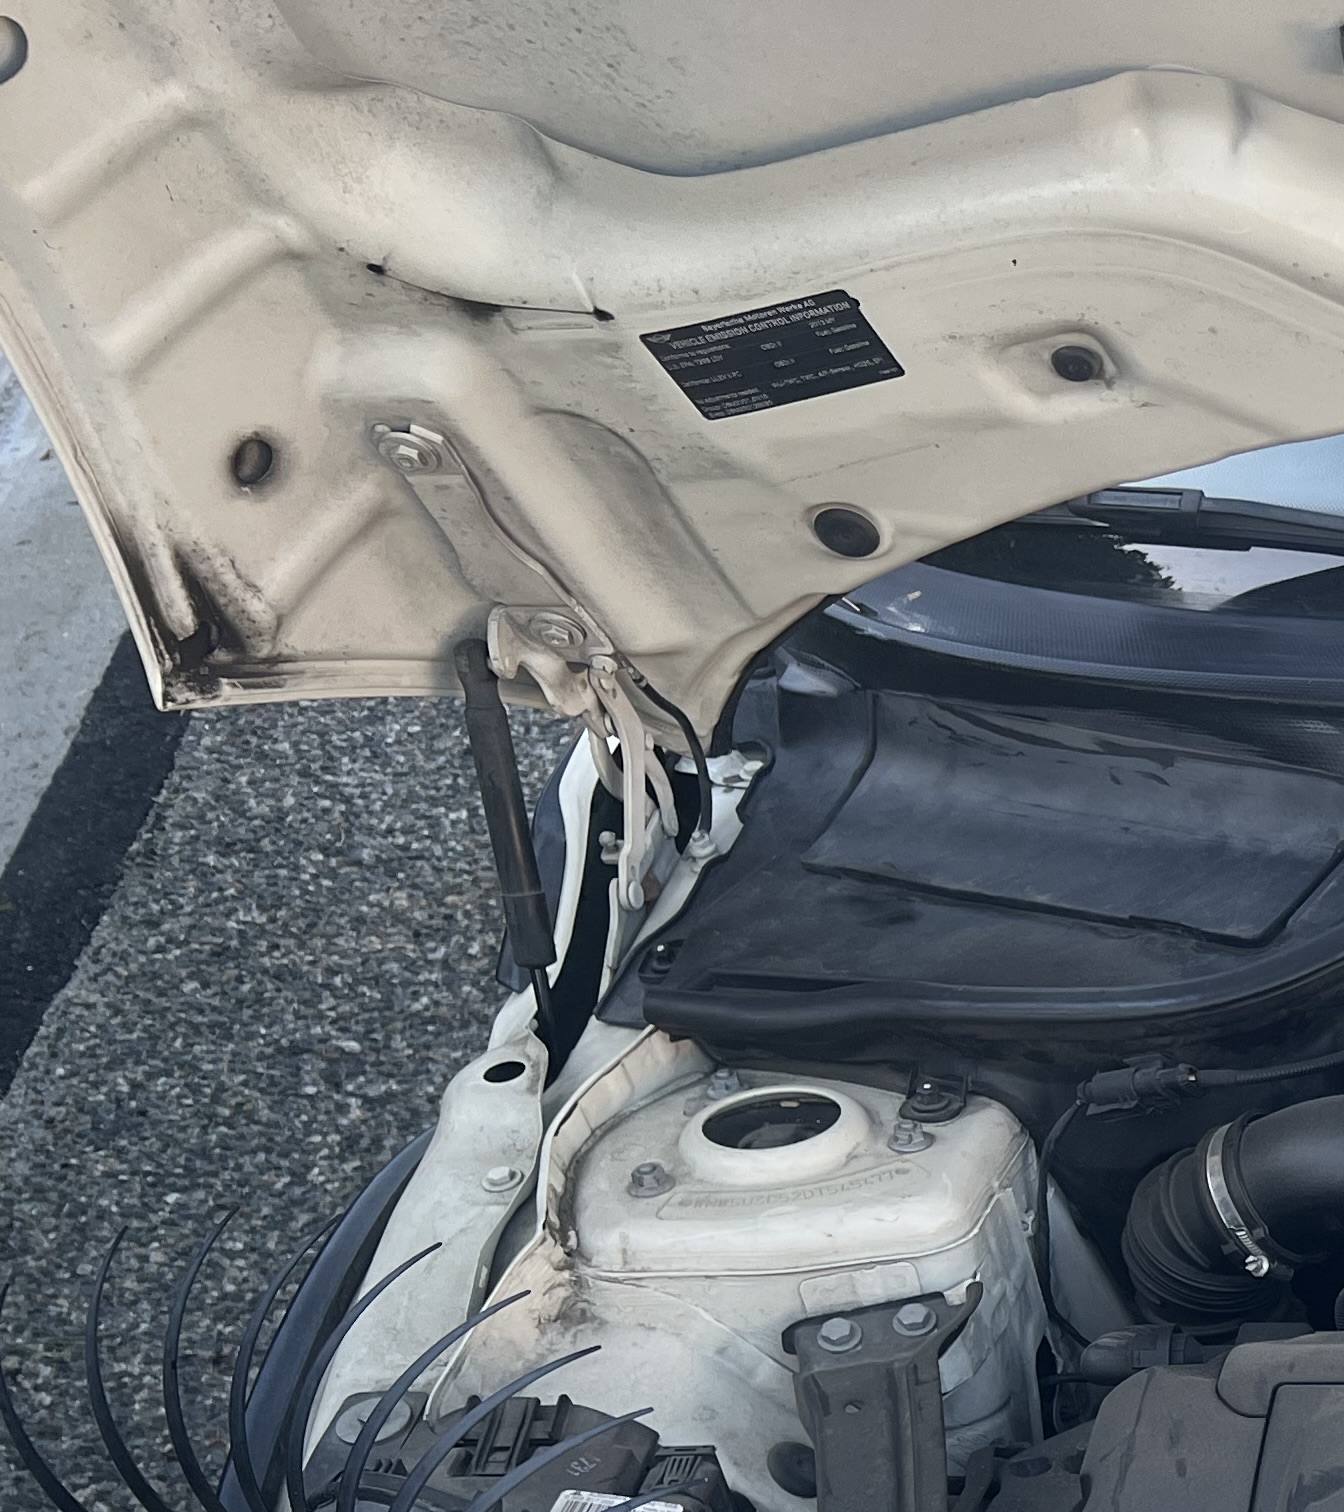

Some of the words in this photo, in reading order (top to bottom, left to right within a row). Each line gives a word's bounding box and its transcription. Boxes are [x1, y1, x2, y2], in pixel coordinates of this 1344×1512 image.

[670, 337, 705, 349] VEHICLE
[705, 327, 747, 341] EMISSION
[748, 317, 789, 331] CONTROL
[788, 302, 850, 321] INFORMATION
